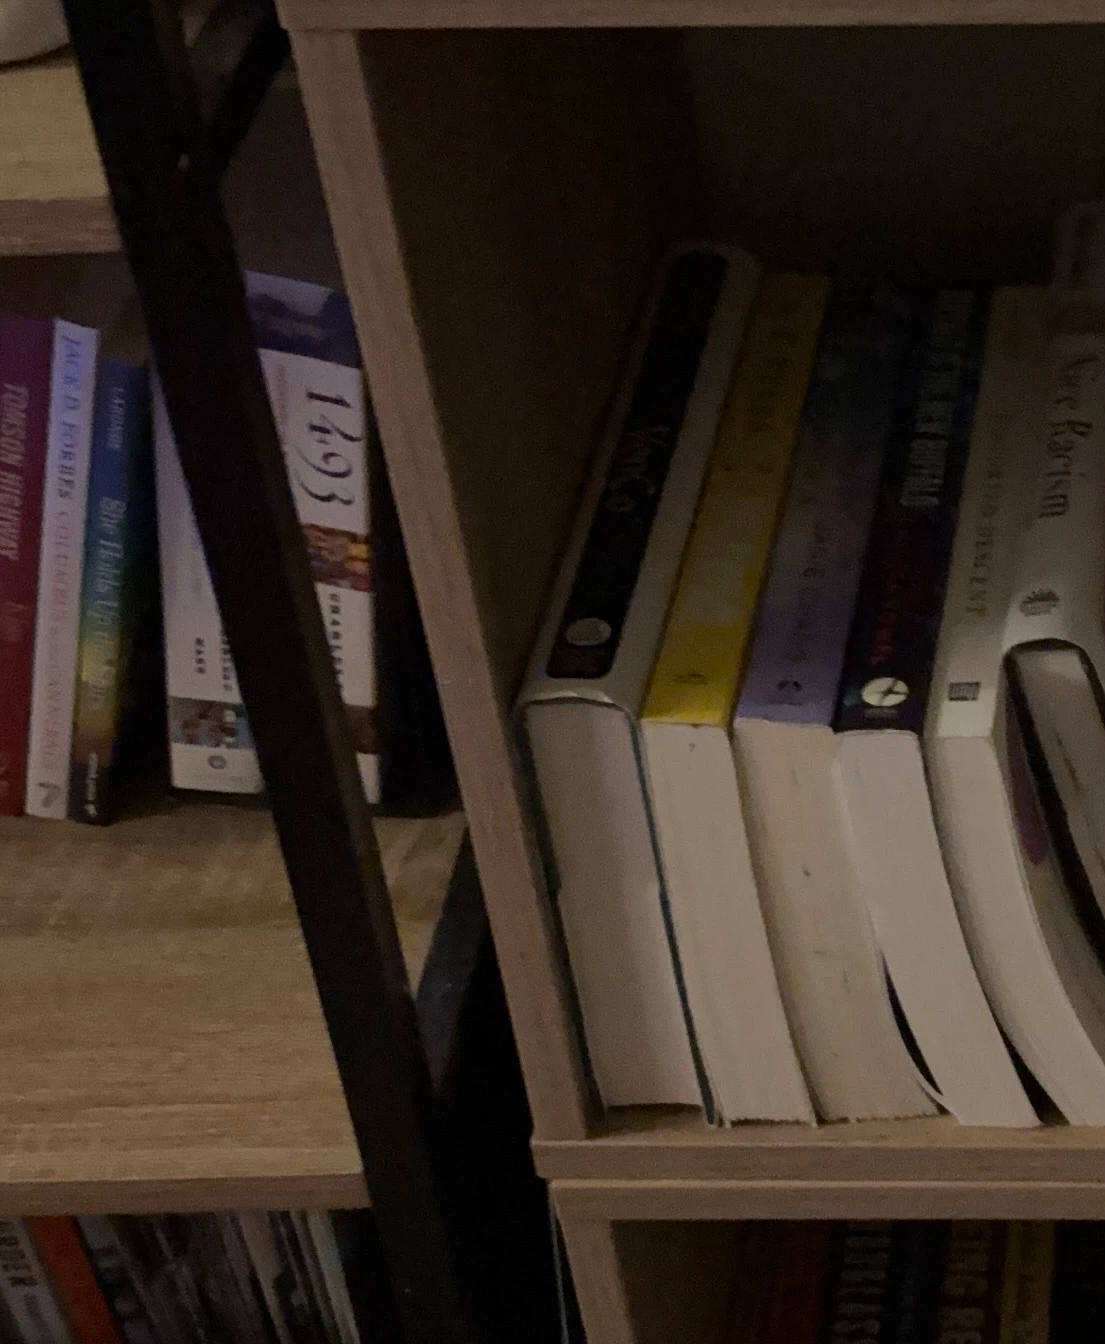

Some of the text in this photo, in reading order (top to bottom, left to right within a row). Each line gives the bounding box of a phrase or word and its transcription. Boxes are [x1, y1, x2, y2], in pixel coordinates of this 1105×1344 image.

[60, 333, 83, 388] JACK
[56, 420, 77, 502] FORBES
[294, 388, 362, 507] 1493
[95, 496, 128, 534] She
